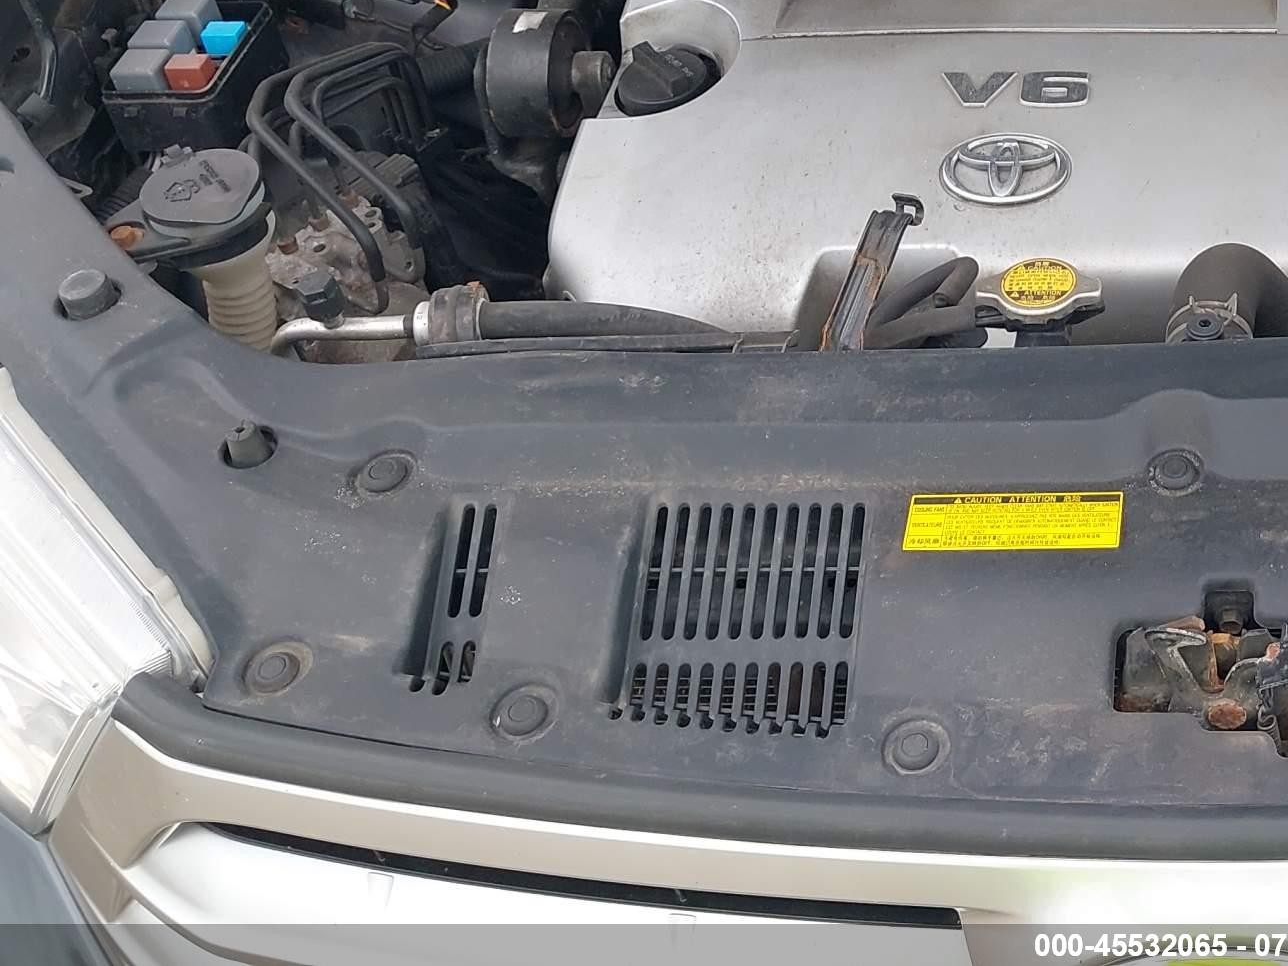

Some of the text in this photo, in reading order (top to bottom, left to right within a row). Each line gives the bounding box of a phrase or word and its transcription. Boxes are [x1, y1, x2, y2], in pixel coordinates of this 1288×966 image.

[941, 70, 1090, 108] V6
[964, 495, 1057, 504] CAUTION ATTENTION
